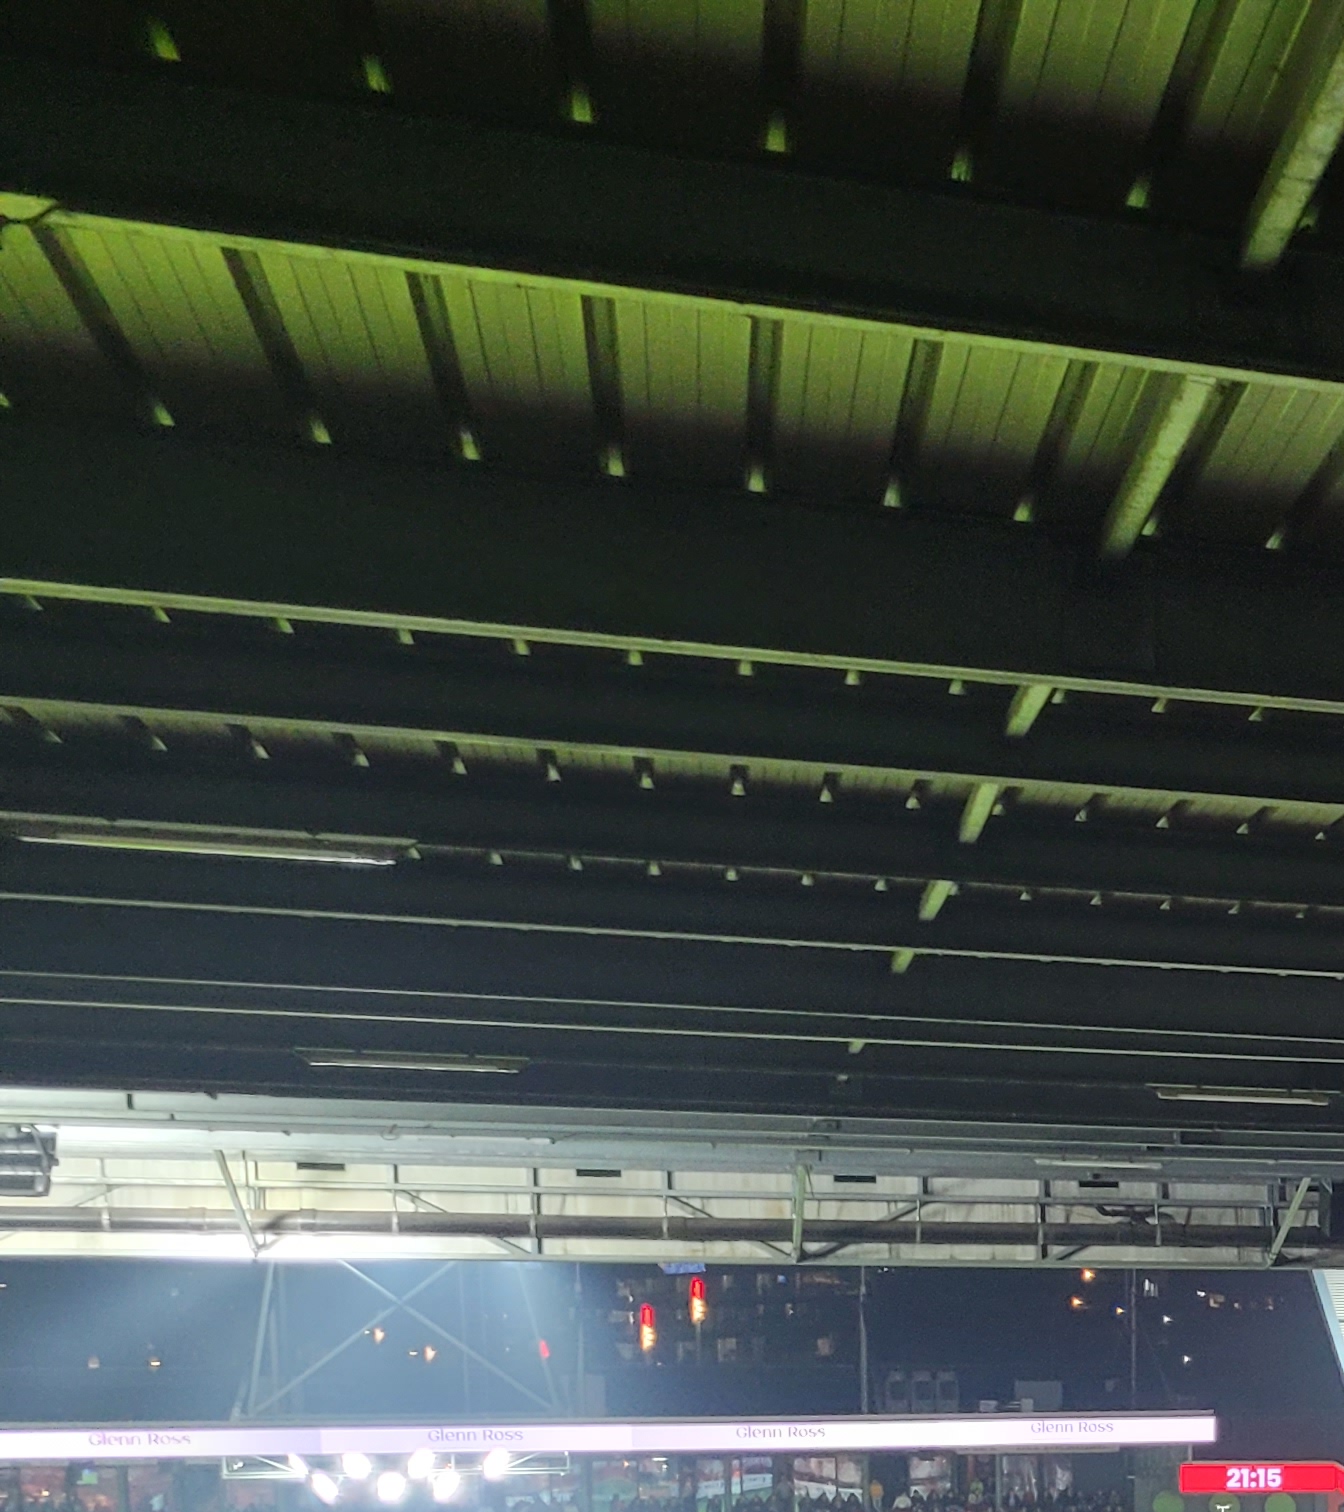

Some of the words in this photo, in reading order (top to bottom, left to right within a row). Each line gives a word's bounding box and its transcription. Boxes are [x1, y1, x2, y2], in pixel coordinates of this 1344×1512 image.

[428, 1427, 476, 1442] Glenn
[482, 1427, 524, 1442] Ross
[735, 1425, 783, 1440] Glenn
[789, 1425, 827, 1439] Ross
[1030, 1420, 1073, 1434] Glenn
[1080, 1420, 1115, 1434] Ross
[88, 1432, 137, 1447] Glenn
[143, 1431, 191, 1446] Ross
[1226, 1467, 1283, 1488] 21:15
